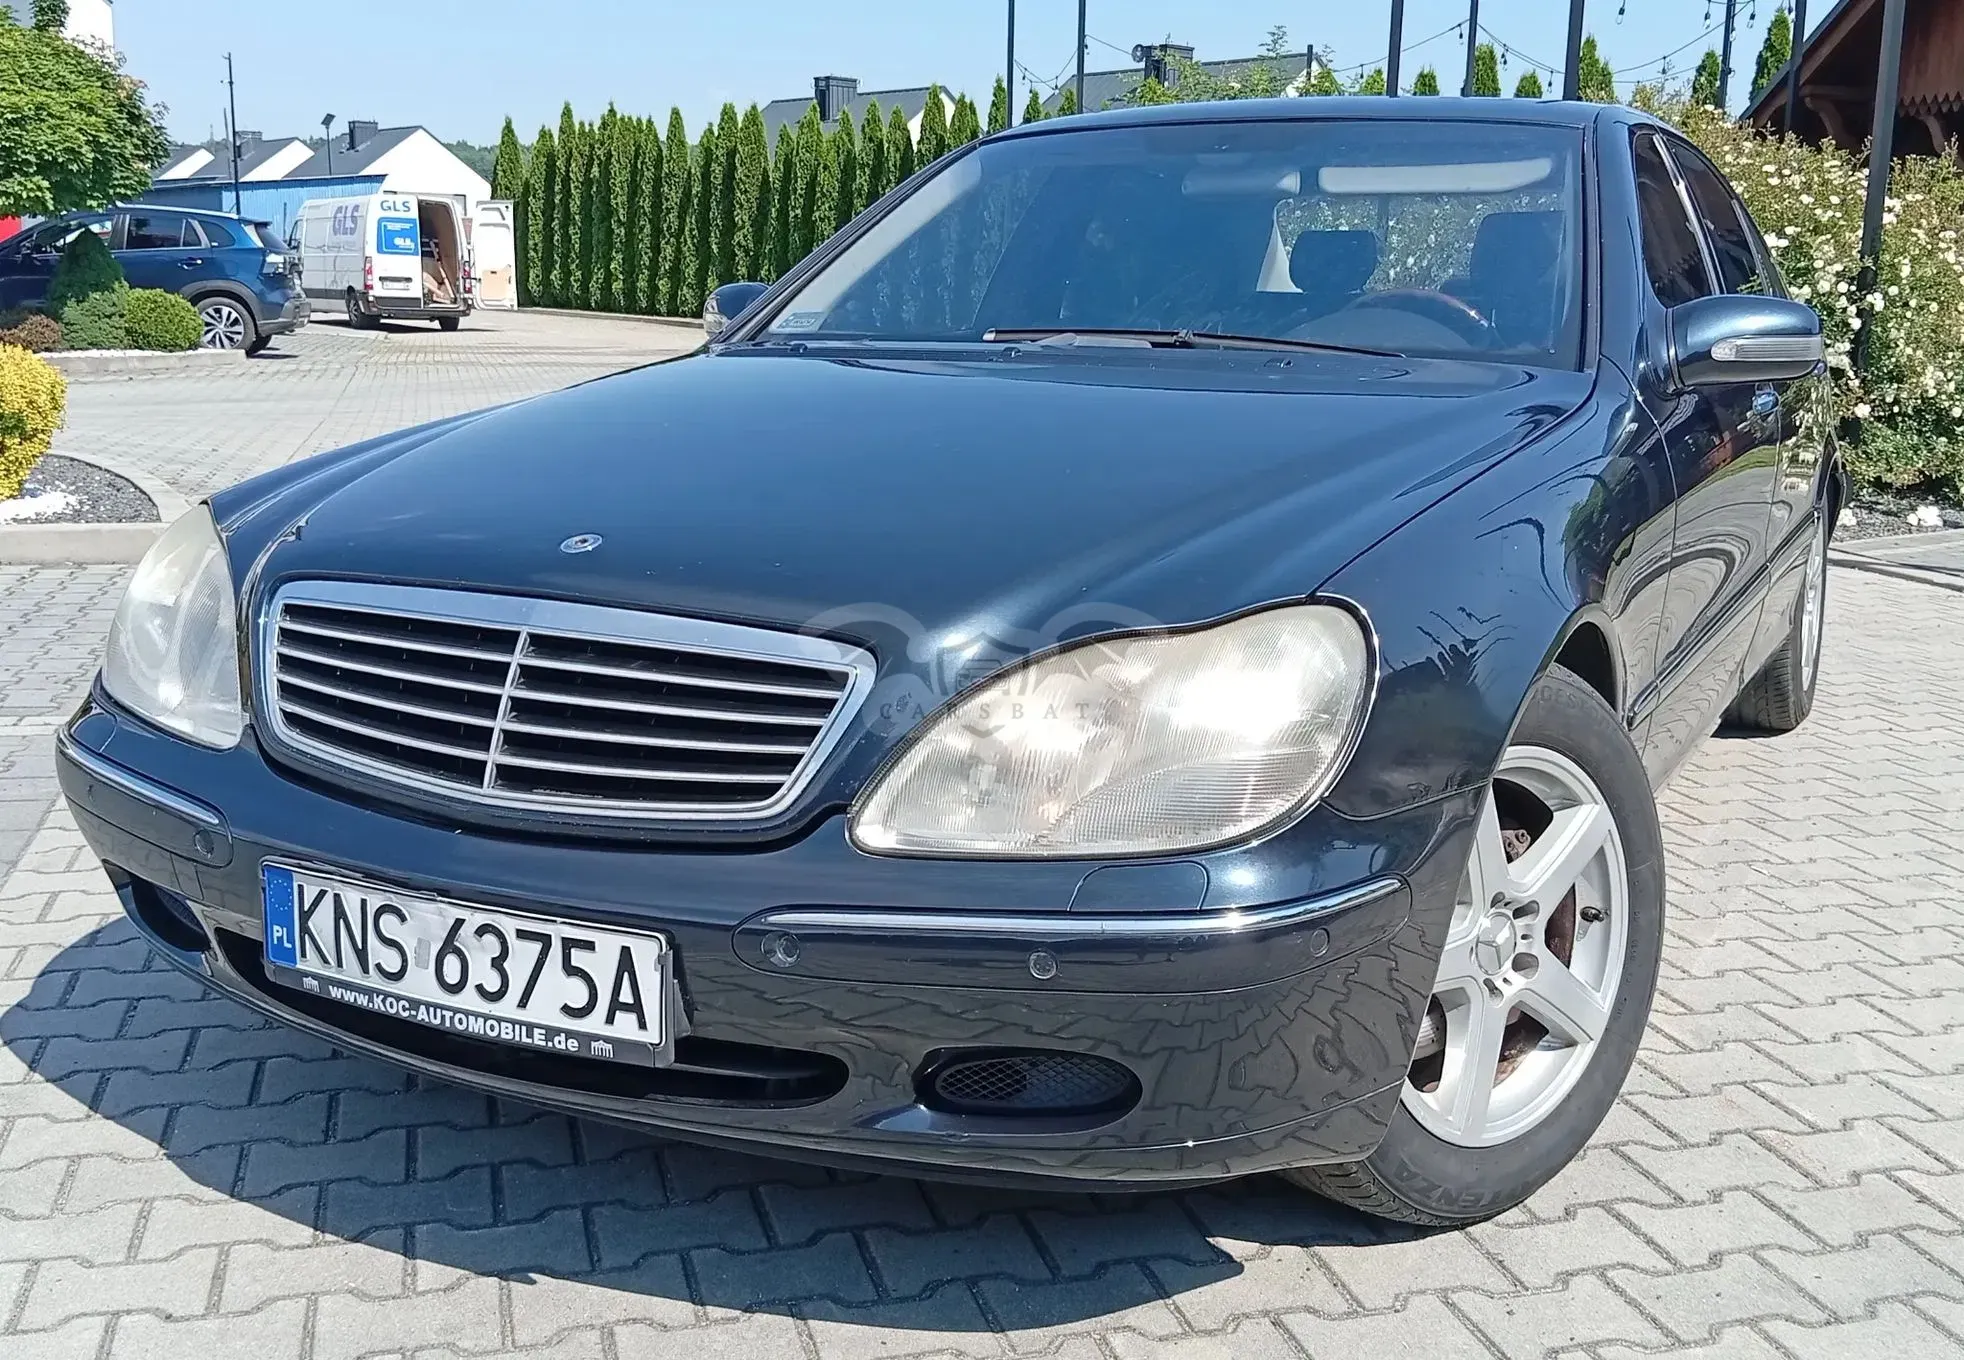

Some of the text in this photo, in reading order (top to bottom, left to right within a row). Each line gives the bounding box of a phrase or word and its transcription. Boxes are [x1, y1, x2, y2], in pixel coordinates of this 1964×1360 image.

[332, 204, 360, 236] GLS
[380, 199, 411, 213] GLS
[272, 924, 293, 949] PL
[297, 883, 649, 1031] KNS 6375A
[328, 984, 579, 1052] www.KOC-AUTOMOBILE.de
